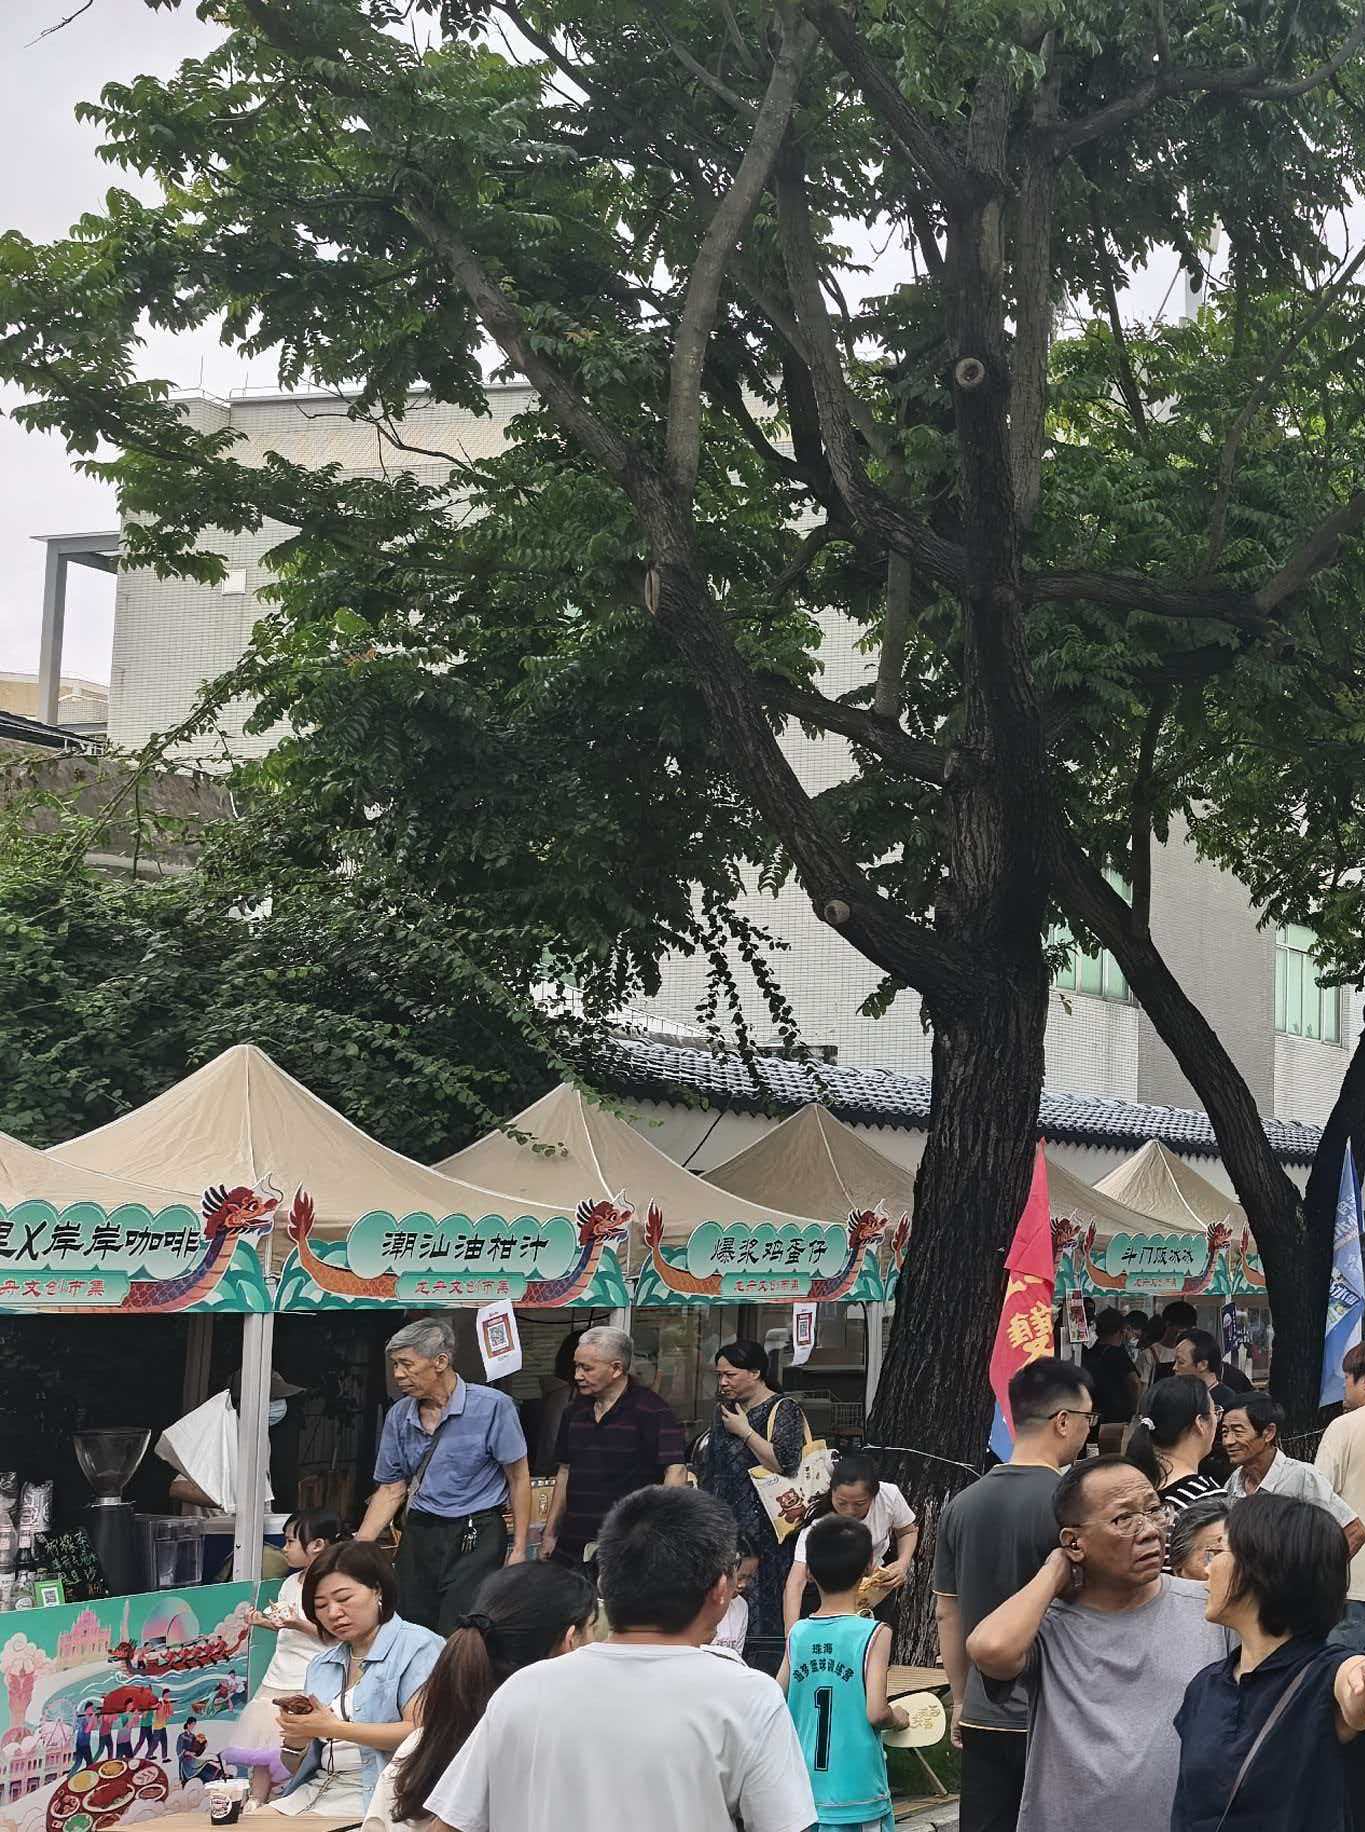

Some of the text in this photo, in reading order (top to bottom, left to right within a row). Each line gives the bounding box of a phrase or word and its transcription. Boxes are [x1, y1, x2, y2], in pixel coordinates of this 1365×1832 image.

[382, 1231, 549, 1263] 潮汕油柑汁
[710, 1237, 828, 1265] 爆浆鸡蛋仔
[814, 1686, 833, 1772] 1
